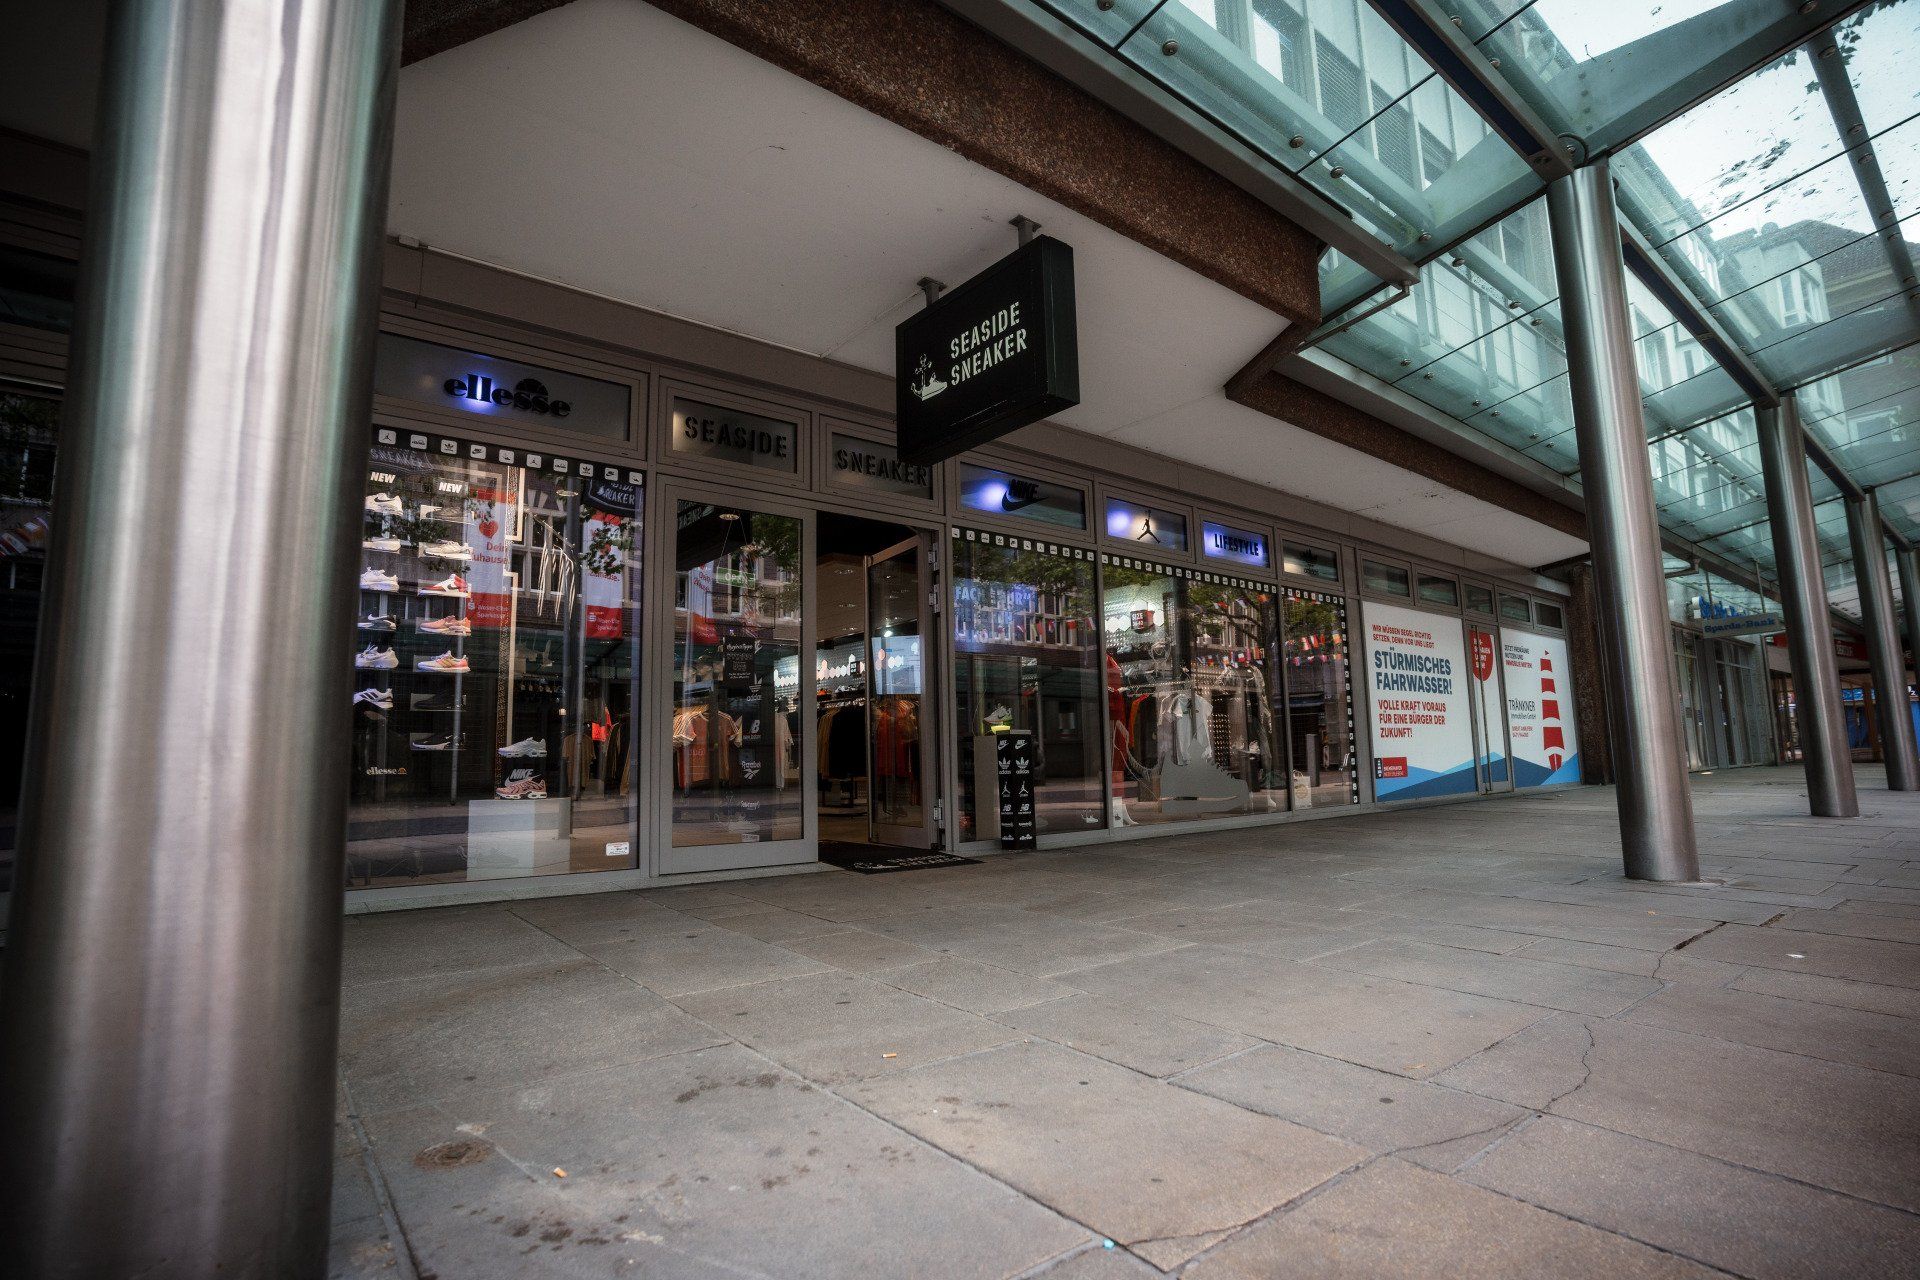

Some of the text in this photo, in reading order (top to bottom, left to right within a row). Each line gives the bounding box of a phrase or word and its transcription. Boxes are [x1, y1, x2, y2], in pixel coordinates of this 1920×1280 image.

[950, 302, 1020, 359] SEASIDE
[951, 329, 1028, 386] SNEAKER
[444, 374, 571, 417] ellesse
[684, 416, 788, 458] SEASIDE
[834, 450, 929, 487] SNEAKER
[370, 471, 396, 484] NEW
[438, 481, 463, 494] NEW
[1214, 533, 1259, 557] LIFESTYLE
[1372, 624, 1381, 632] WIR
[1382, 625, 1400, 635] MÜSSEN
[1392, 636, 1404, 644] DENN
[1374, 646, 1452, 675] STÜRMISCHES
[1376, 671, 1453, 695] FAHRWASSER!
[1378, 699, 1447, 713] VOLLE KRAFT VORAUS
[1508, 698, 1536, 711] TRÄNKNER
[1379, 711, 1446, 725] FÜR EINE BÜRGER DER
[1380, 727, 1413, 738] ZUKUNFT!
[366, 766, 398, 776] ellesse
[509, 768, 535, 780] NIKE
